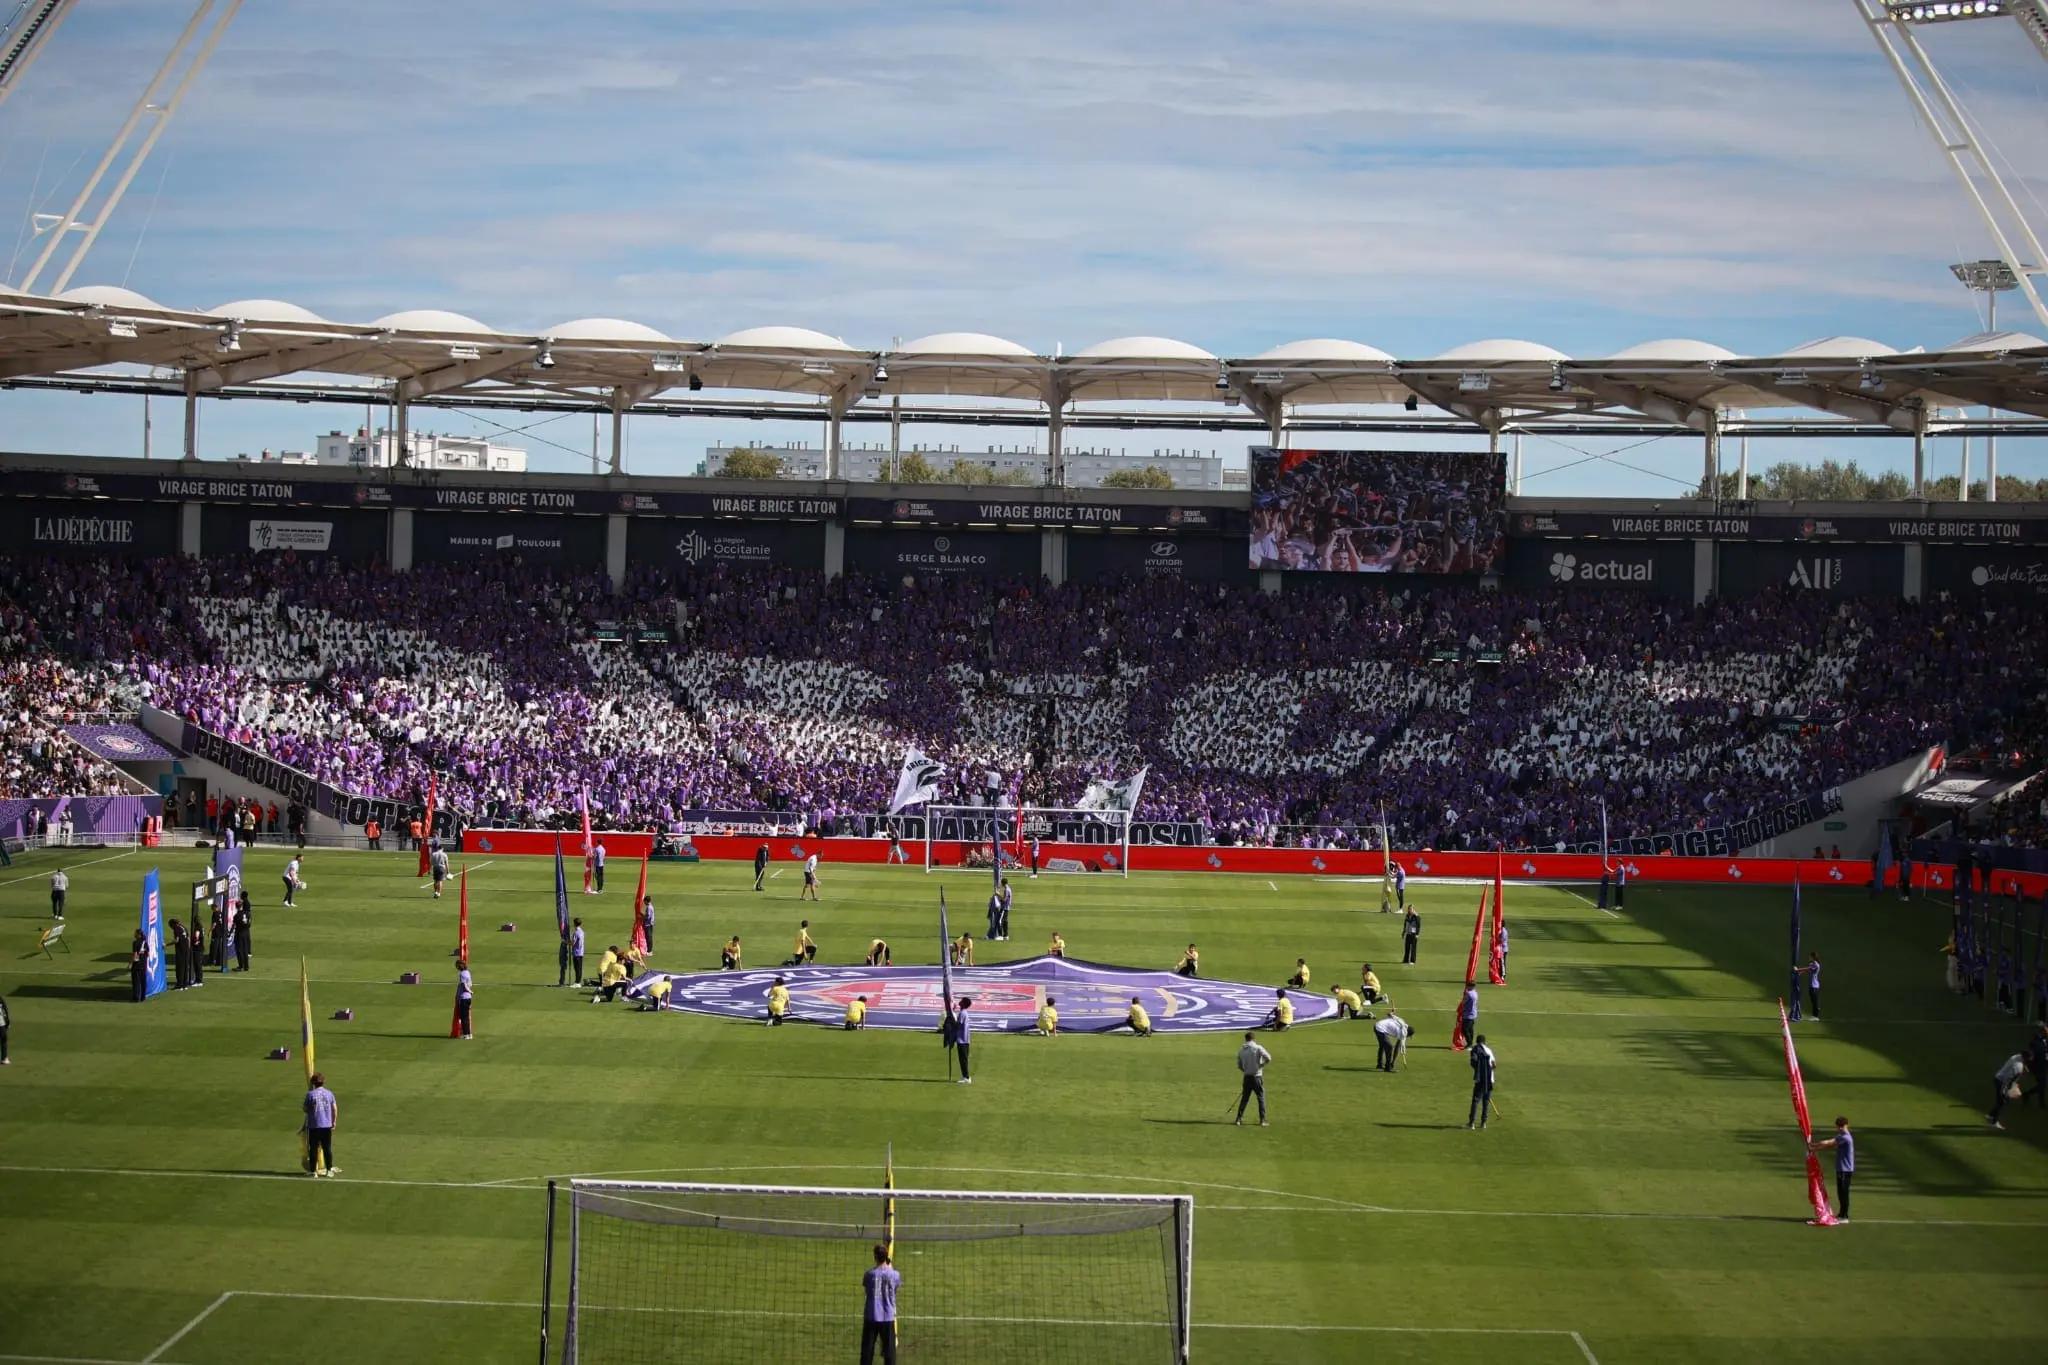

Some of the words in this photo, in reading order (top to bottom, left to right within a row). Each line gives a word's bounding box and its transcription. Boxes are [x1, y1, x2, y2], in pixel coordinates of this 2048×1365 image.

[159, 480, 205, 495] VIRAGE
[209, 482, 247, 497] BRICE
[250, 484, 293, 498] TATON
[436, 490, 484, 505] VIRAGE
[489, 492, 527, 506] BRICE
[531, 493, 575, 507] TATON
[712, 498, 755, 512] VIRAGE
[759, 499, 794, 513] BRICE
[800, 500, 837, 514] TATON
[979, 504, 1029, 519] VIRAGE
[1033, 506, 1072, 520] BRICE
[1077, 507, 1121, 521] TATON
[33, 517, 55, 541] LA
[57, 515, 133, 543] DÉPÊCHE
[1611, 518, 1660, 532] VIRAGE
[1664, 518, 1703, 533] BRICE
[1706, 519, 1749, 534] TATON
[1889, 522, 1934, 536] VIRAGE
[1938, 523, 1975, 537] BRICE
[1979, 524, 2020, 538] TATON
[450, 537, 479, 545] MAIRIE
[517, 539, 561, 548] TOULOUSE
[714, 544, 771, 555] Occitanie
[897, 554, 935, 563] SERGE
[940, 555, 986, 564] BLANCO
[1580, 559, 1653, 581] actual
[1986, 563, 2010, 584] Sud
[237, 749, 318, 811] TOLOSA
[1731, 797, 1814, 849] TOLOSA
